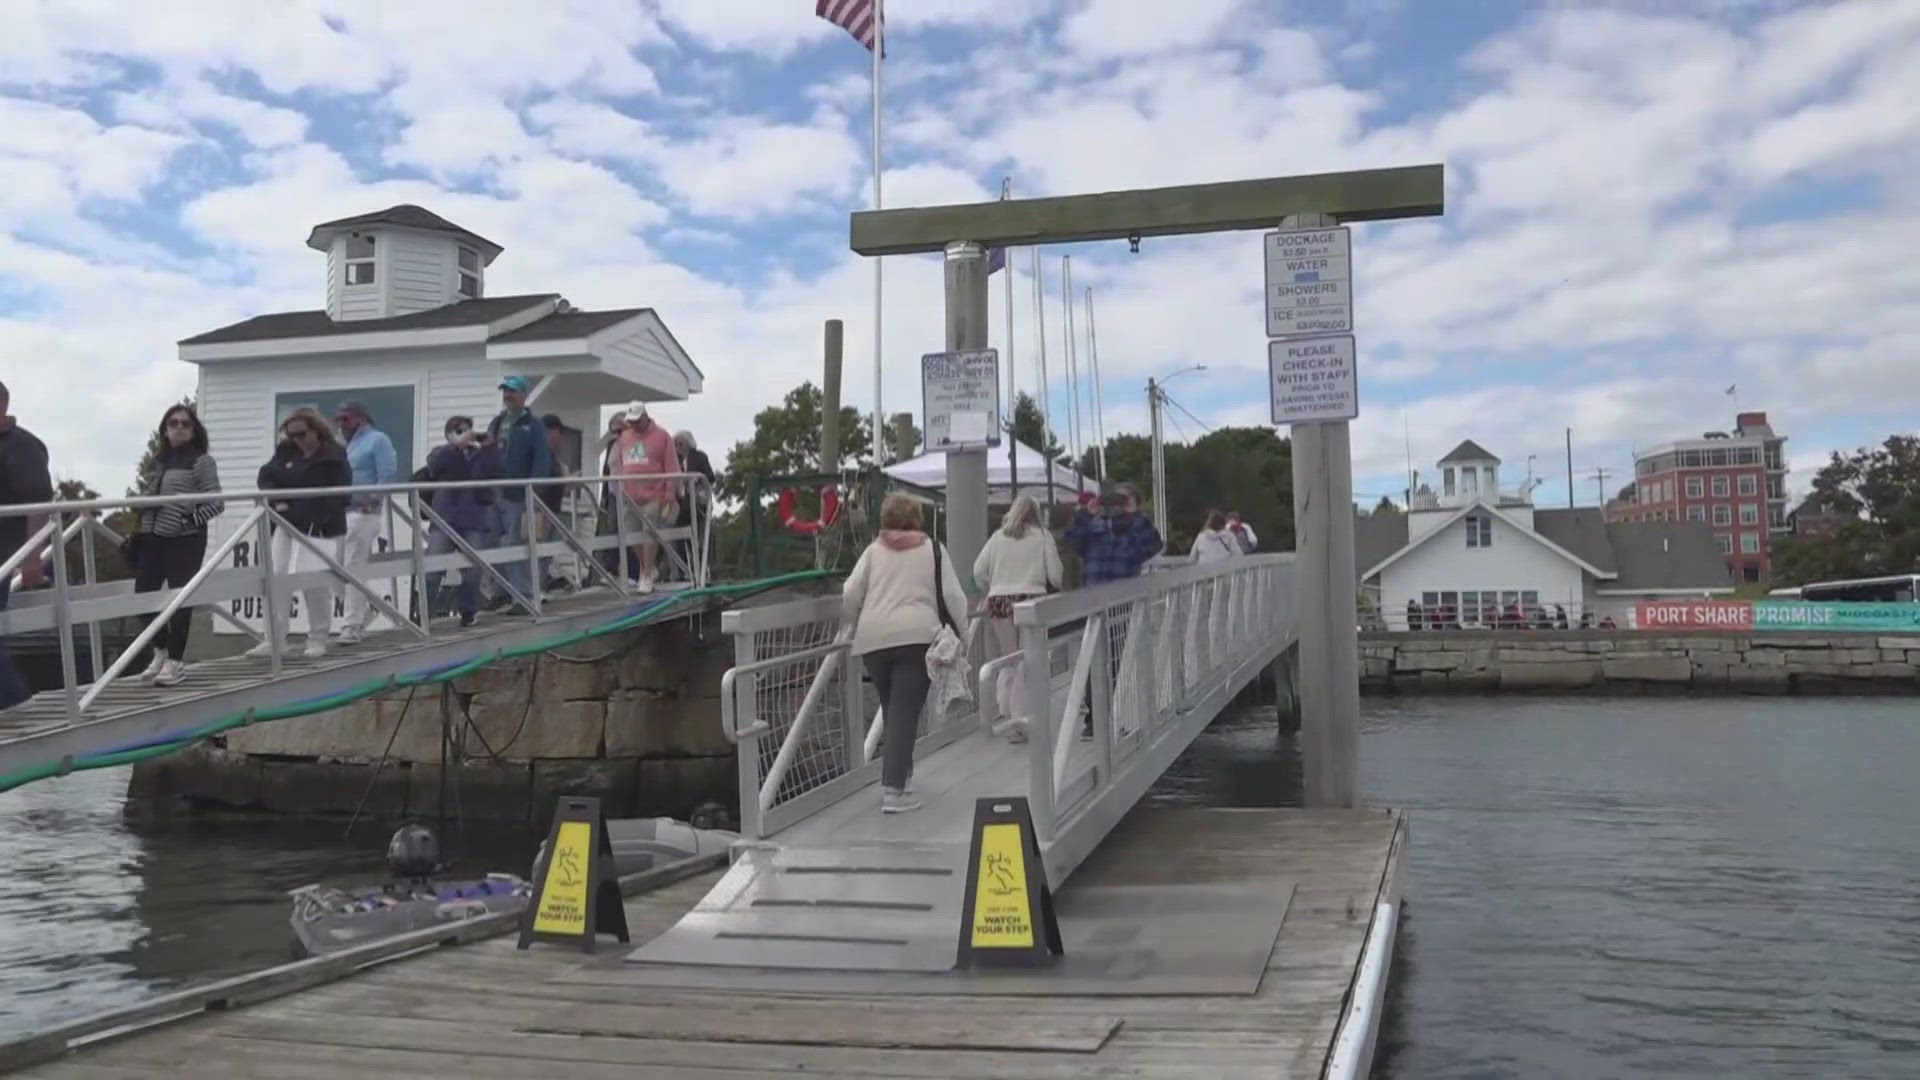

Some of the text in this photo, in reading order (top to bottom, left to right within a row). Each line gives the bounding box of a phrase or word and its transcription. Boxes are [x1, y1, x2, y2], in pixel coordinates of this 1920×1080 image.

[1277, 233, 1336, 247] DOCKAGE
[1286, 259, 1328, 271] WATER
[1278, 283, 1337, 297] SHOWERS
[1273, 309, 1294, 320] ICE
[1288, 344, 1335, 357] PLEASE
[1282, 357, 1343, 371] CHECK-IN
[1277, 369, 1350, 385] WITH STAFF
[1292, 382, 1335, 392] PRIOR TO
[1317, 391, 1350, 401] VESSEL
[1284, 402, 1345, 414] UNATTENDED
[1646, 606, 1688, 625] PORT
[1694, 606, 1749, 625] SHARE
[1756, 606, 1834, 625] PROMISE
[548, 904, 579, 912] WATCH
[540, 912, 583, 922] YOUR STEP
[976, 925, 1029, 934] YOUR STEP
